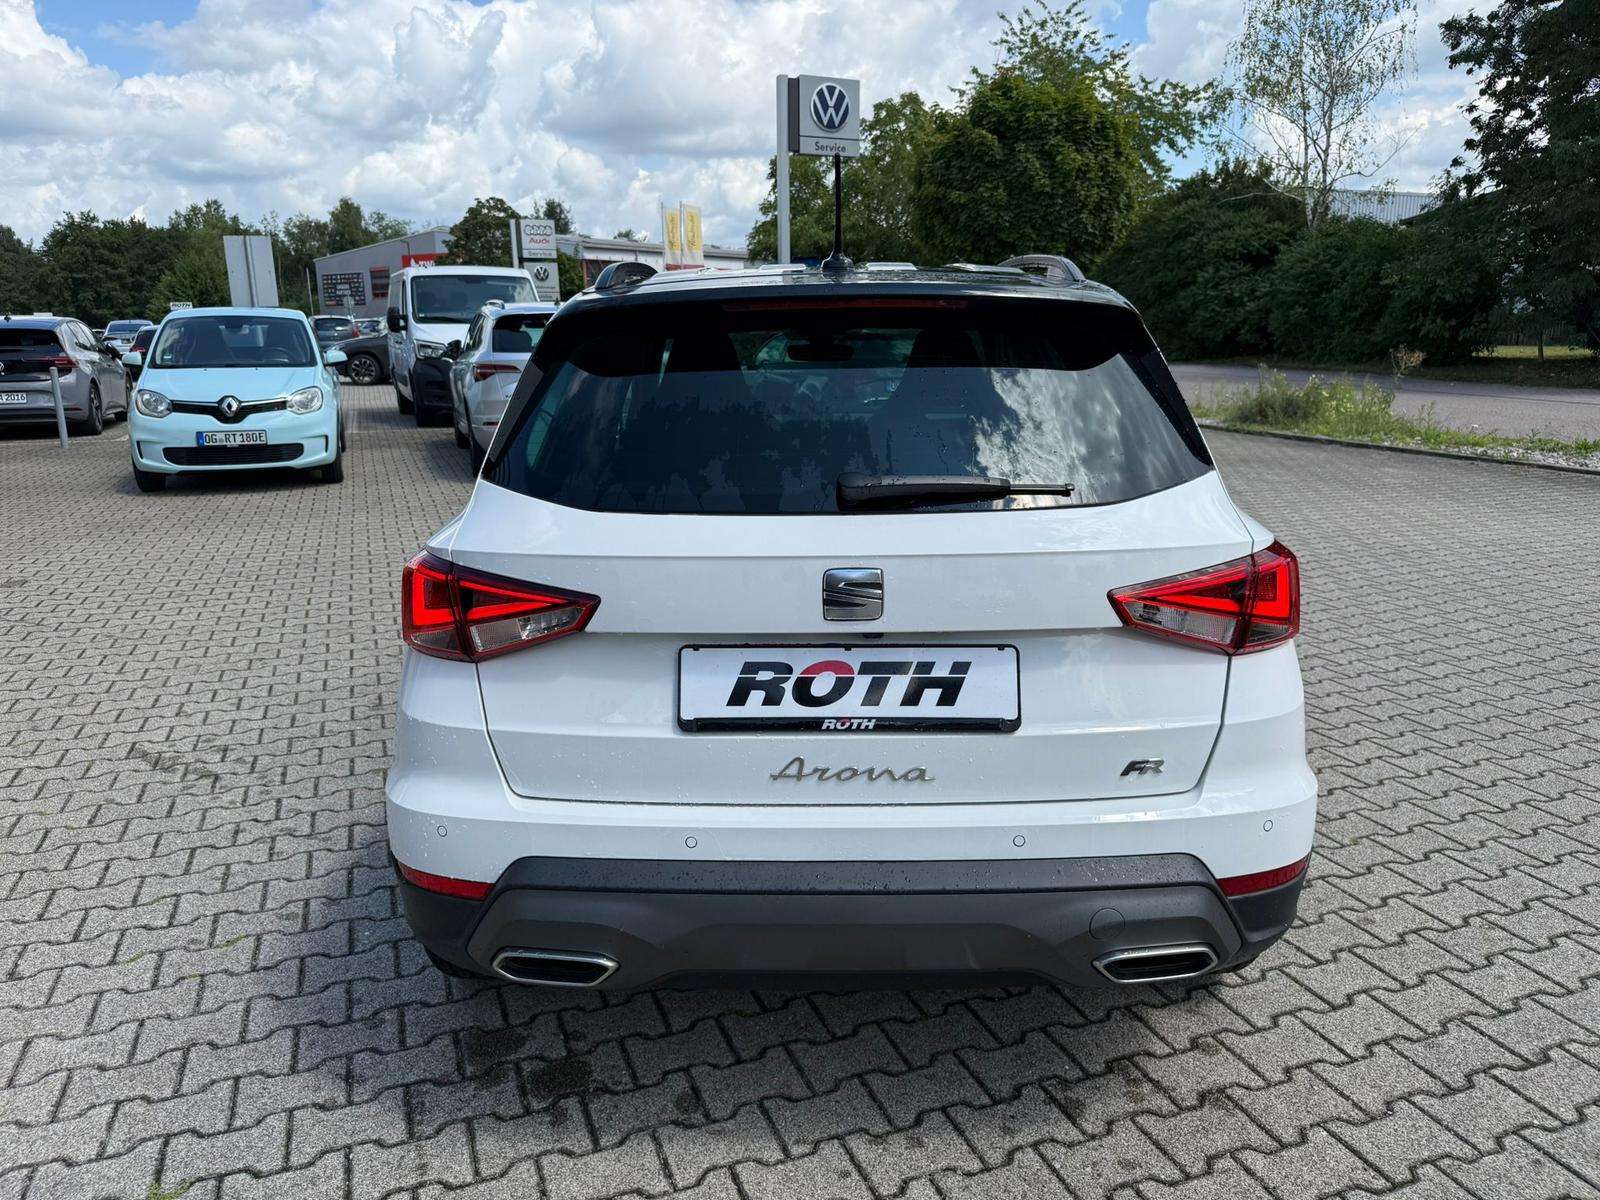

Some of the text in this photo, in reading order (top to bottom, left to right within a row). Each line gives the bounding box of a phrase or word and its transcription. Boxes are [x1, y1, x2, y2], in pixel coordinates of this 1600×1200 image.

[814, 141, 847, 153] Service
[528, 237, 551, 245] Audi
[204, 433, 218, 444] OG
[224, 433, 239, 443] RT
[726, 659, 972, 708] ROTH
[821, 718, 876, 730] ROTH
[769, 755, 936, 785] Arona
[1120, 757, 1165, 777] FR
